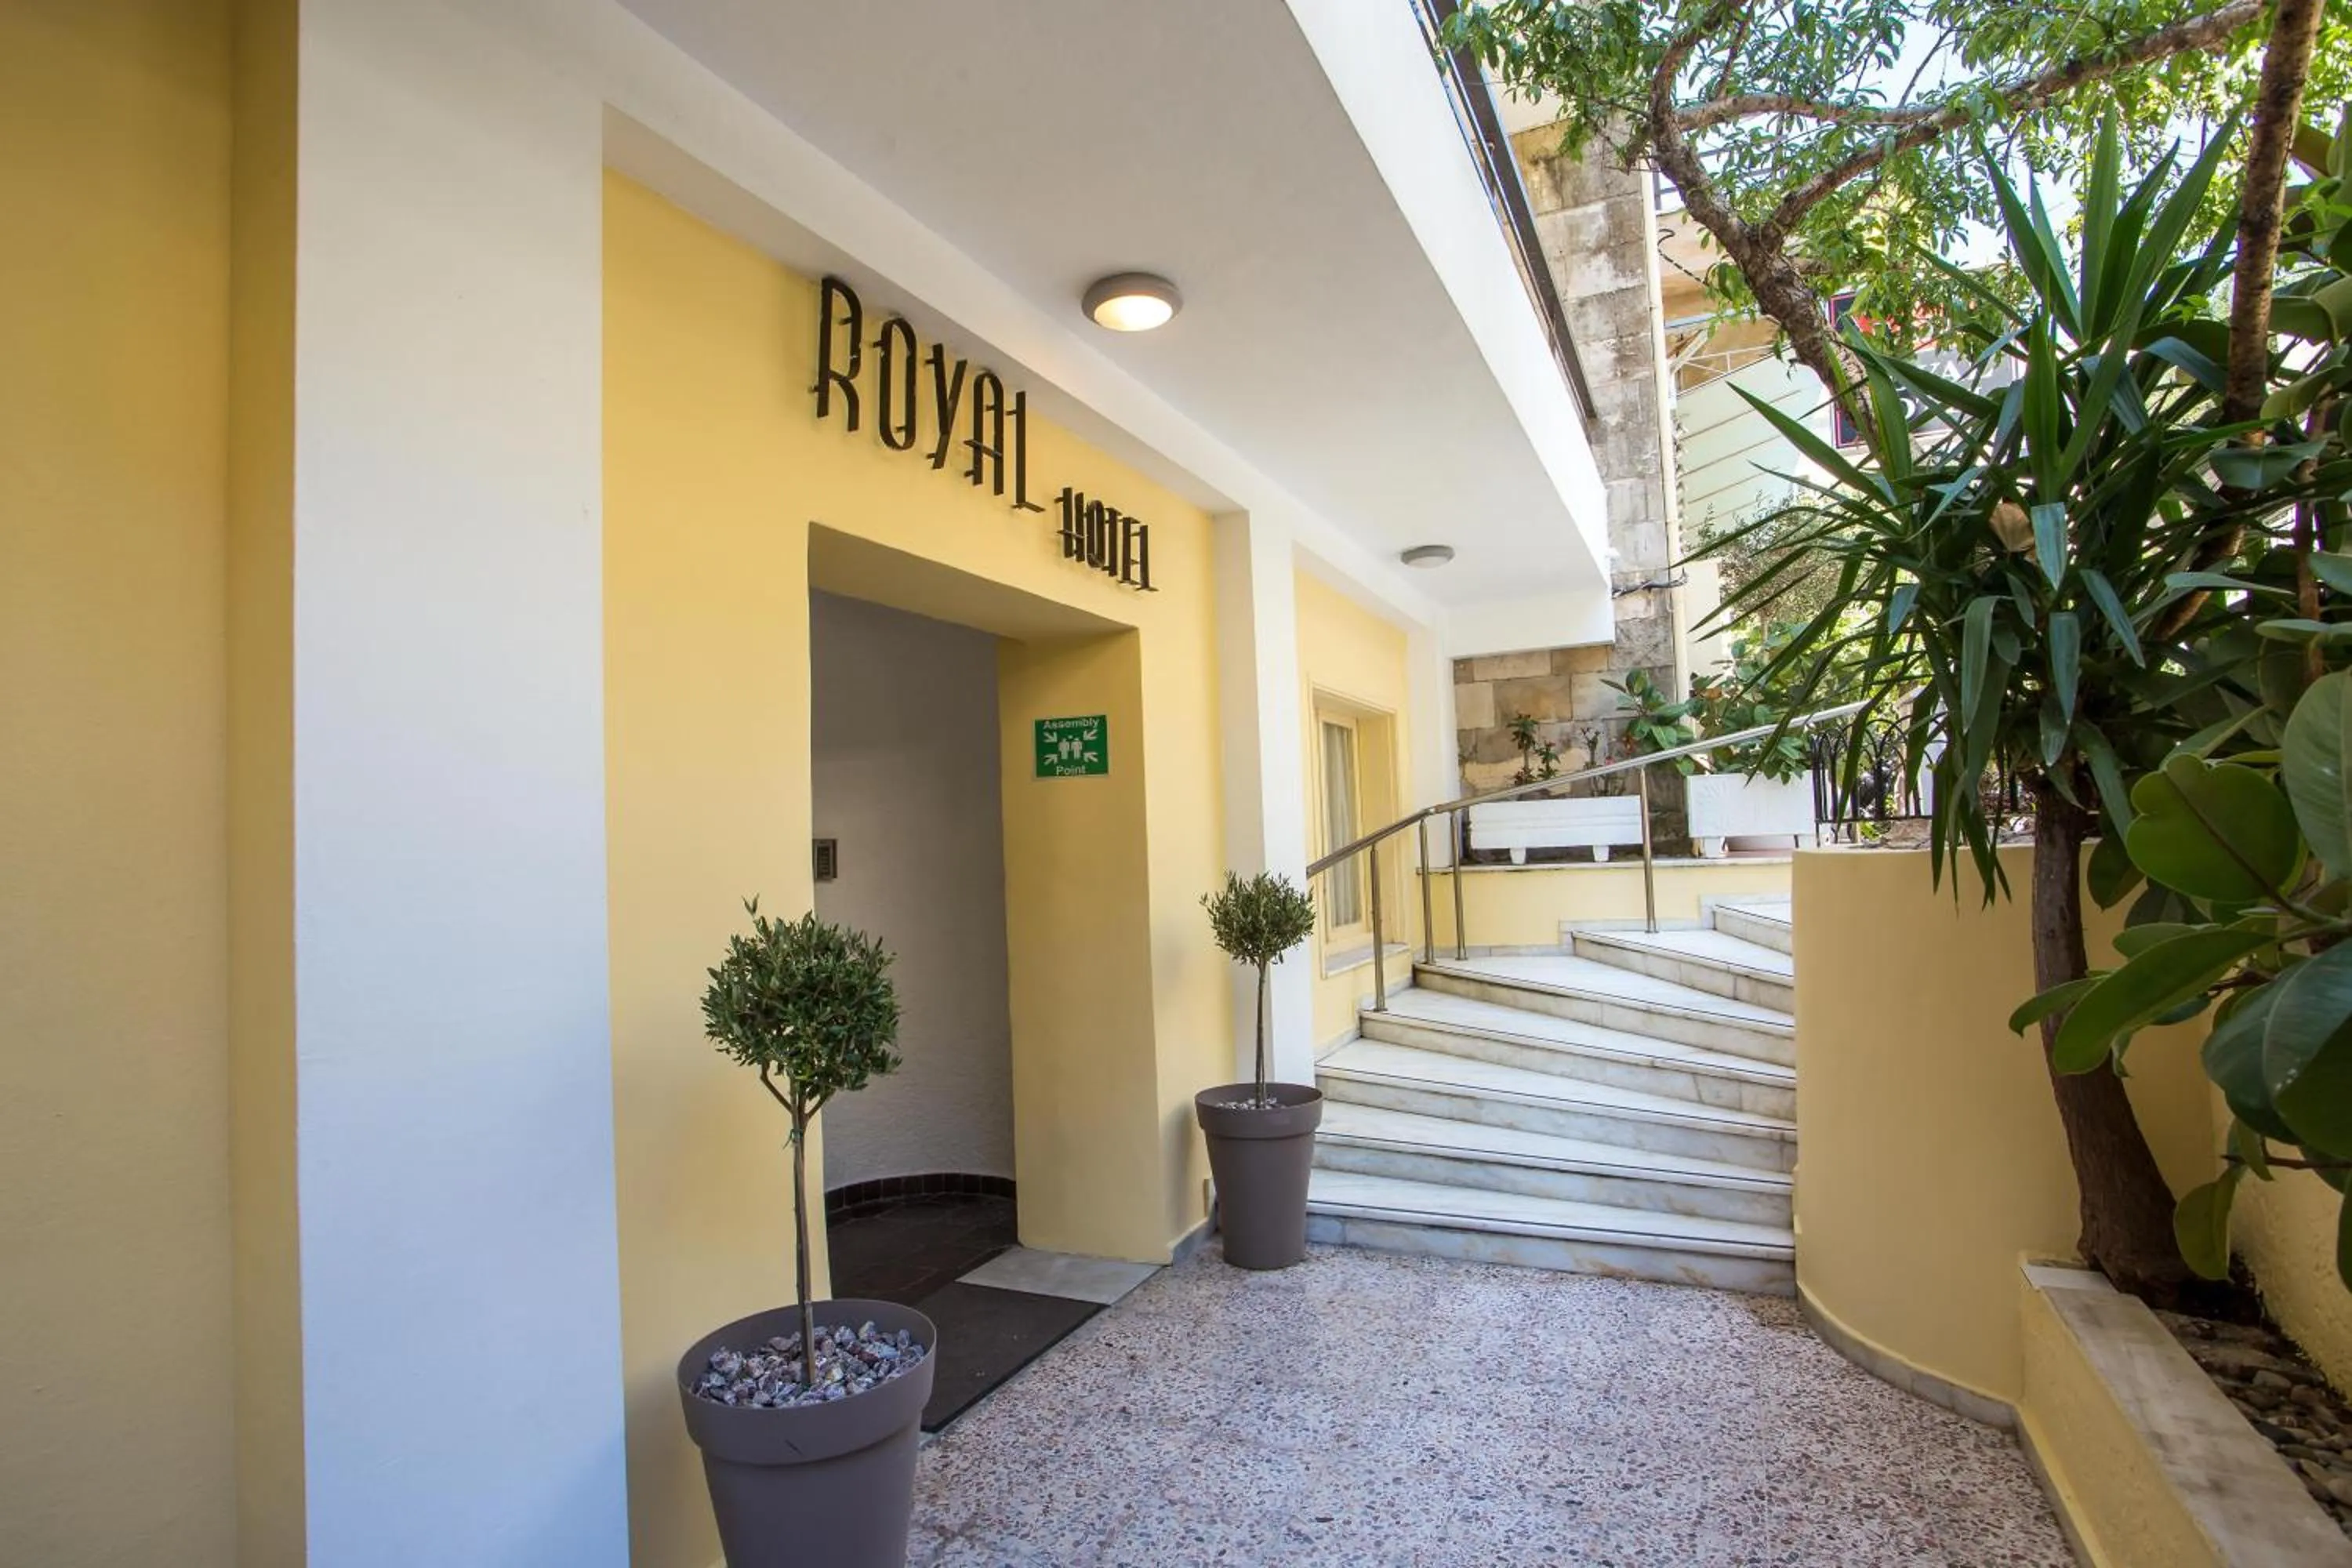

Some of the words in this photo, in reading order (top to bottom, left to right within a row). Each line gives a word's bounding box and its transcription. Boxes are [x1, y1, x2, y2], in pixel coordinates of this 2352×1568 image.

[817, 276, 1045, 513] ROYAL
[1056, 487, 1159, 592] HOTEL
[1043, 717, 1098, 730] Assembly
[1055, 765, 1086, 775] Point
